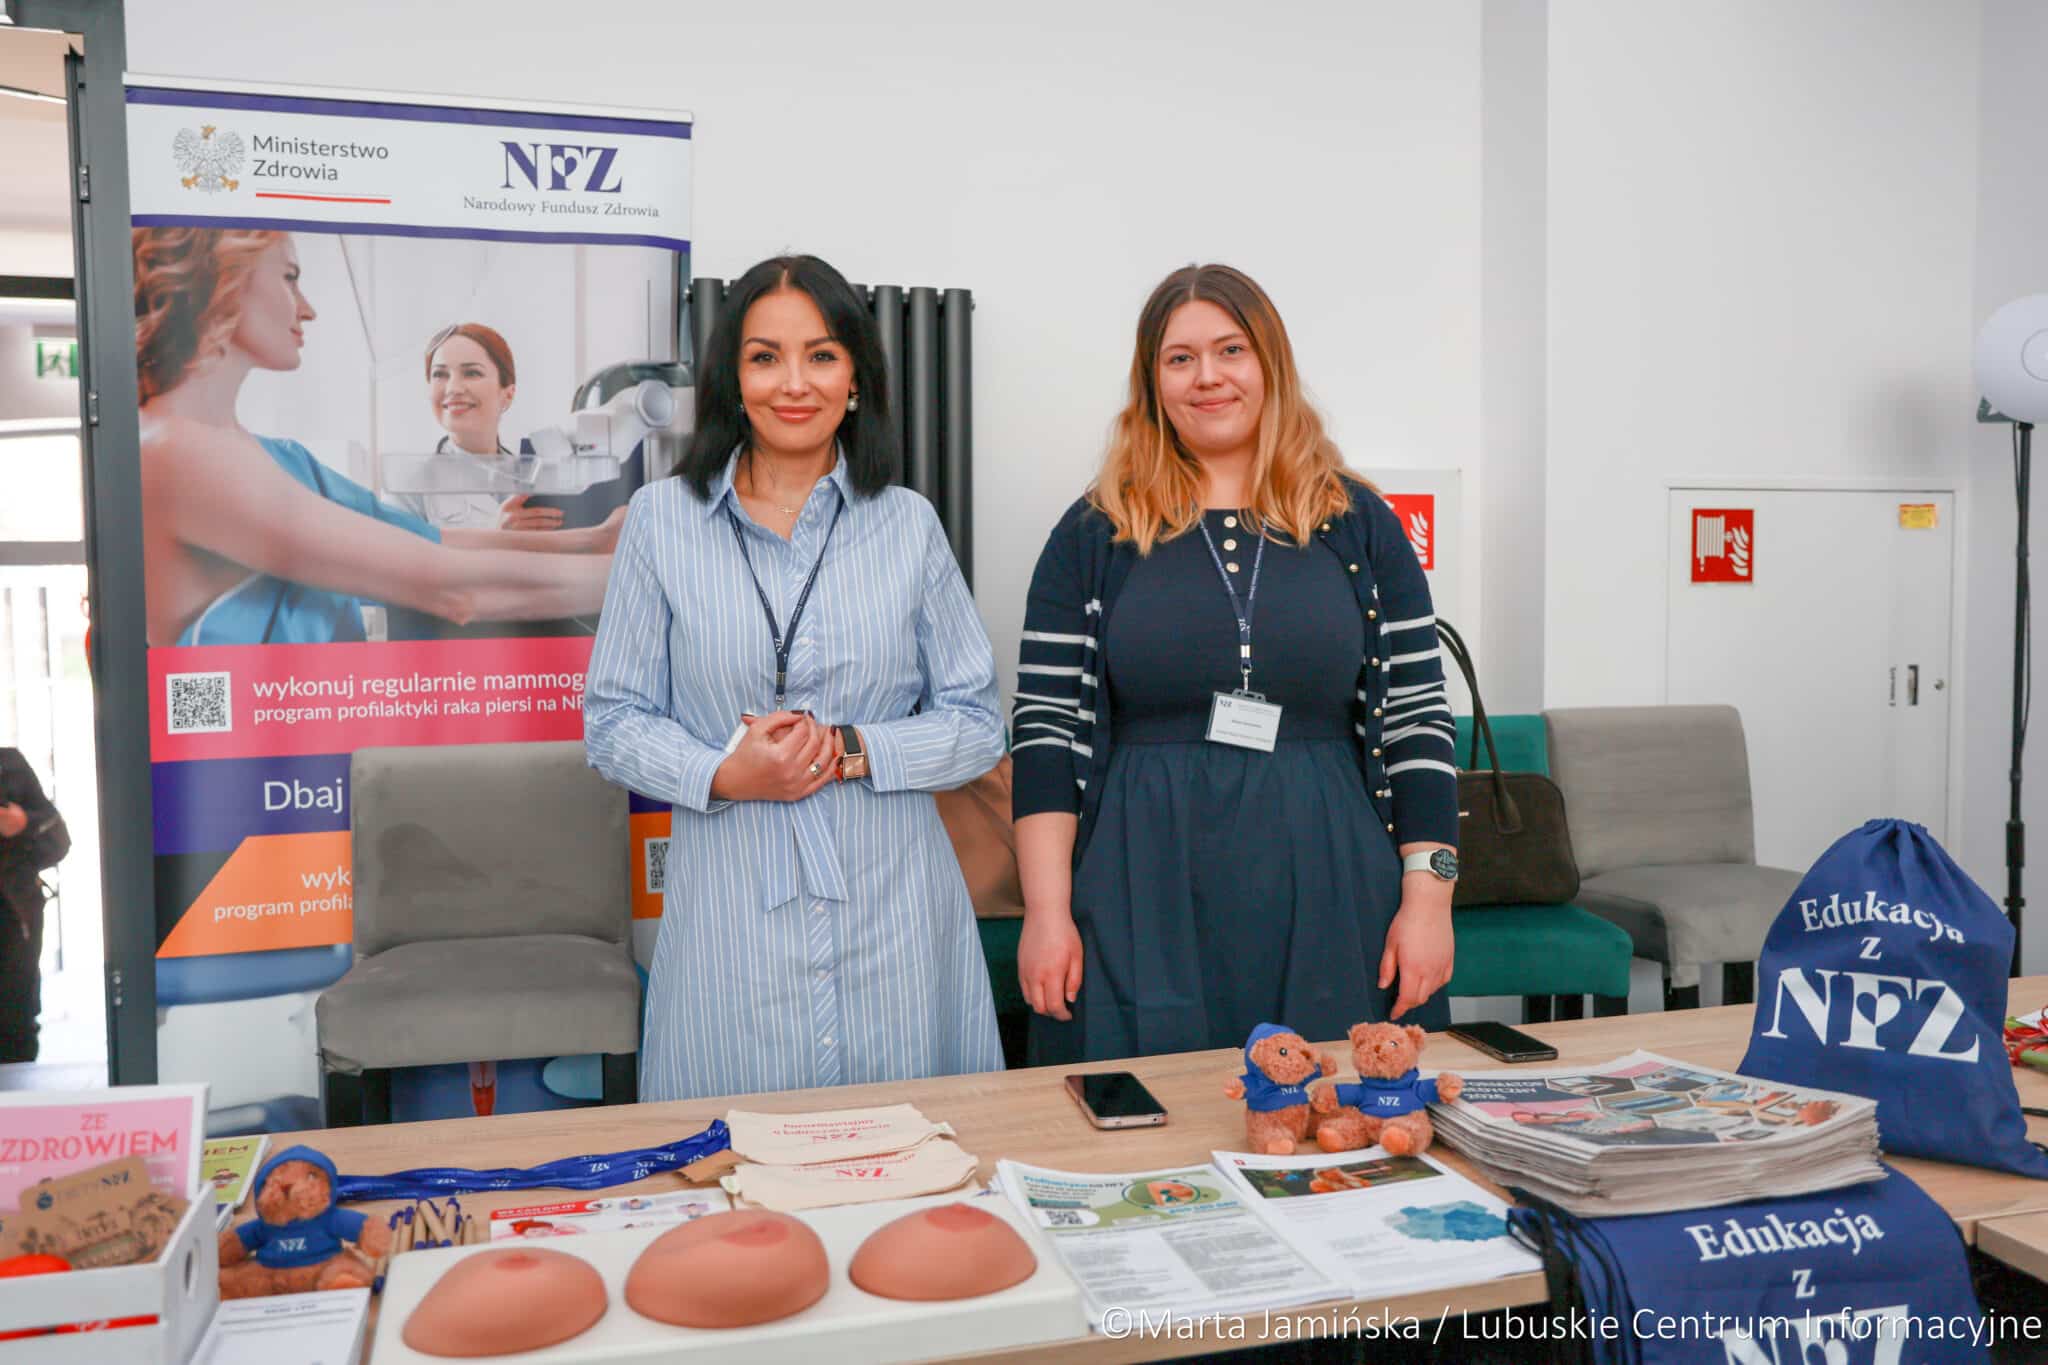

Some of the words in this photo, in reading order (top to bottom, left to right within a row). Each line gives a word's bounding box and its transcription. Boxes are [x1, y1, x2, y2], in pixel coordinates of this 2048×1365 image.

[253, 134, 389, 160] Ministerstwo
[253, 159, 339, 181] Zdrowia
[500, 140, 624, 194] NFZ
[463, 196, 537, 215] Narodowy
[541, 199, 599, 216] Fundusz
[603, 201, 660, 218] Zdrowia
[252, 674, 355, 701] wykonuj
[361, 670, 477, 697] regularnie
[483, 672, 585, 692] mammog
[253, 703, 333, 724] program
[337, 699, 438, 722] profilaktyki
[443, 697, 481, 715] raka
[485, 695, 532, 717] piersi
[537, 698, 557, 712] na
[263, 777, 344, 814] Dbaj
[301, 865, 352, 891] wyk
[213, 900, 295, 924] program
[1799, 891, 1966, 944] Edukacja
[1859, 936, 1882, 960] z
[1761, 967, 1980, 1064] NFZ
[1378, 1095, 1401, 1107] NFZ
[80, 1113, 108, 1132] ZE
[0, 1129, 178, 1163] ZDROWIEM
[1684, 1207, 1886, 1261] Edukacja
[1792, 1269, 1816, 1299] z
